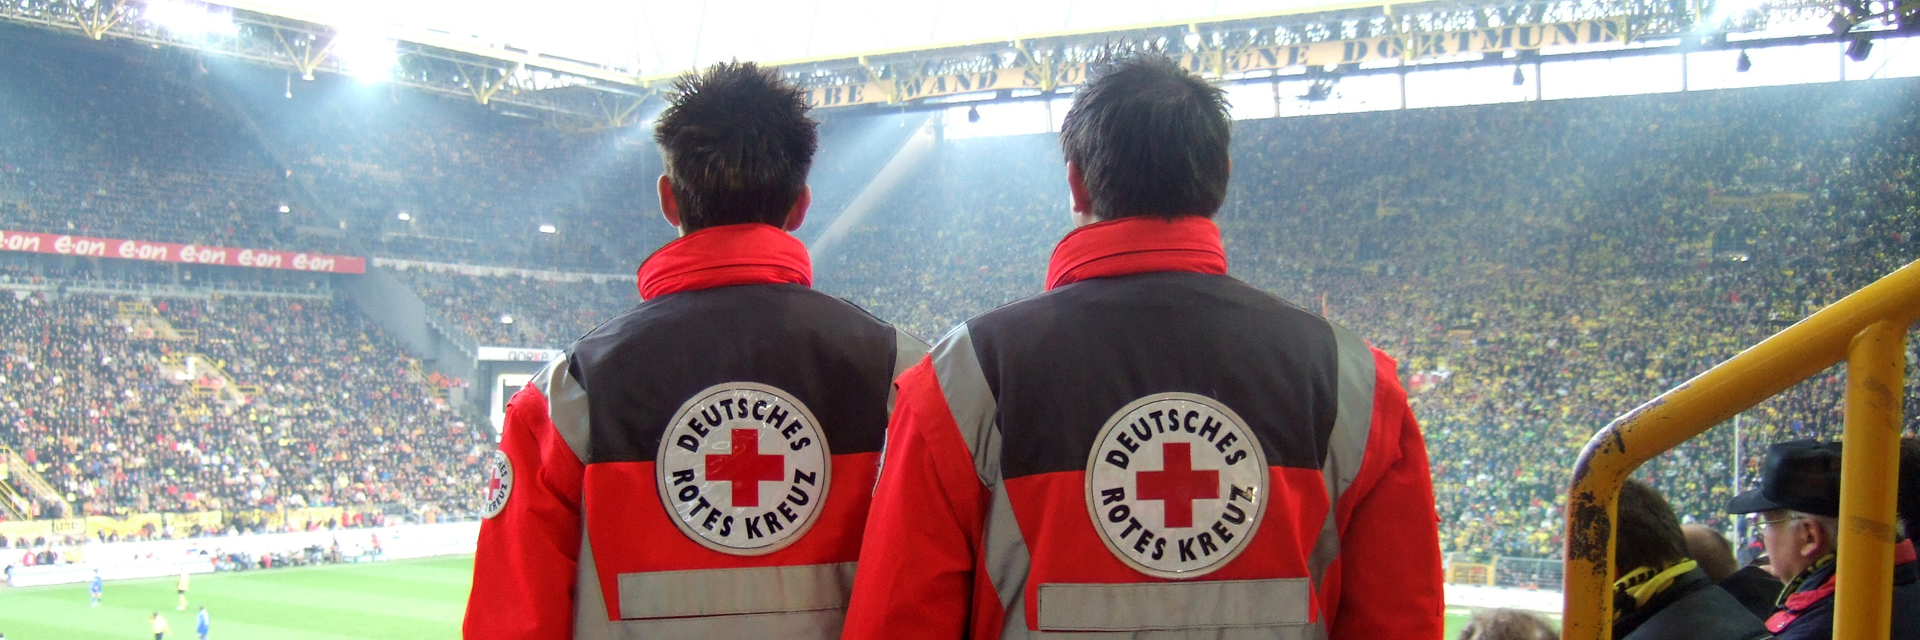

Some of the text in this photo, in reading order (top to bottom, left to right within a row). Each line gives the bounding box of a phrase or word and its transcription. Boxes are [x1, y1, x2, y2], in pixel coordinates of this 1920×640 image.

[1343, 18, 1621, 61] DORTMUND
[677, 398, 811, 453] DEUTSCHES
[1105, 409, 1247, 470] DEUTSCHES
[672, 468, 816, 539] ROTES KREUZ
[1101, 484, 1254, 562] ROTES KREUZ
